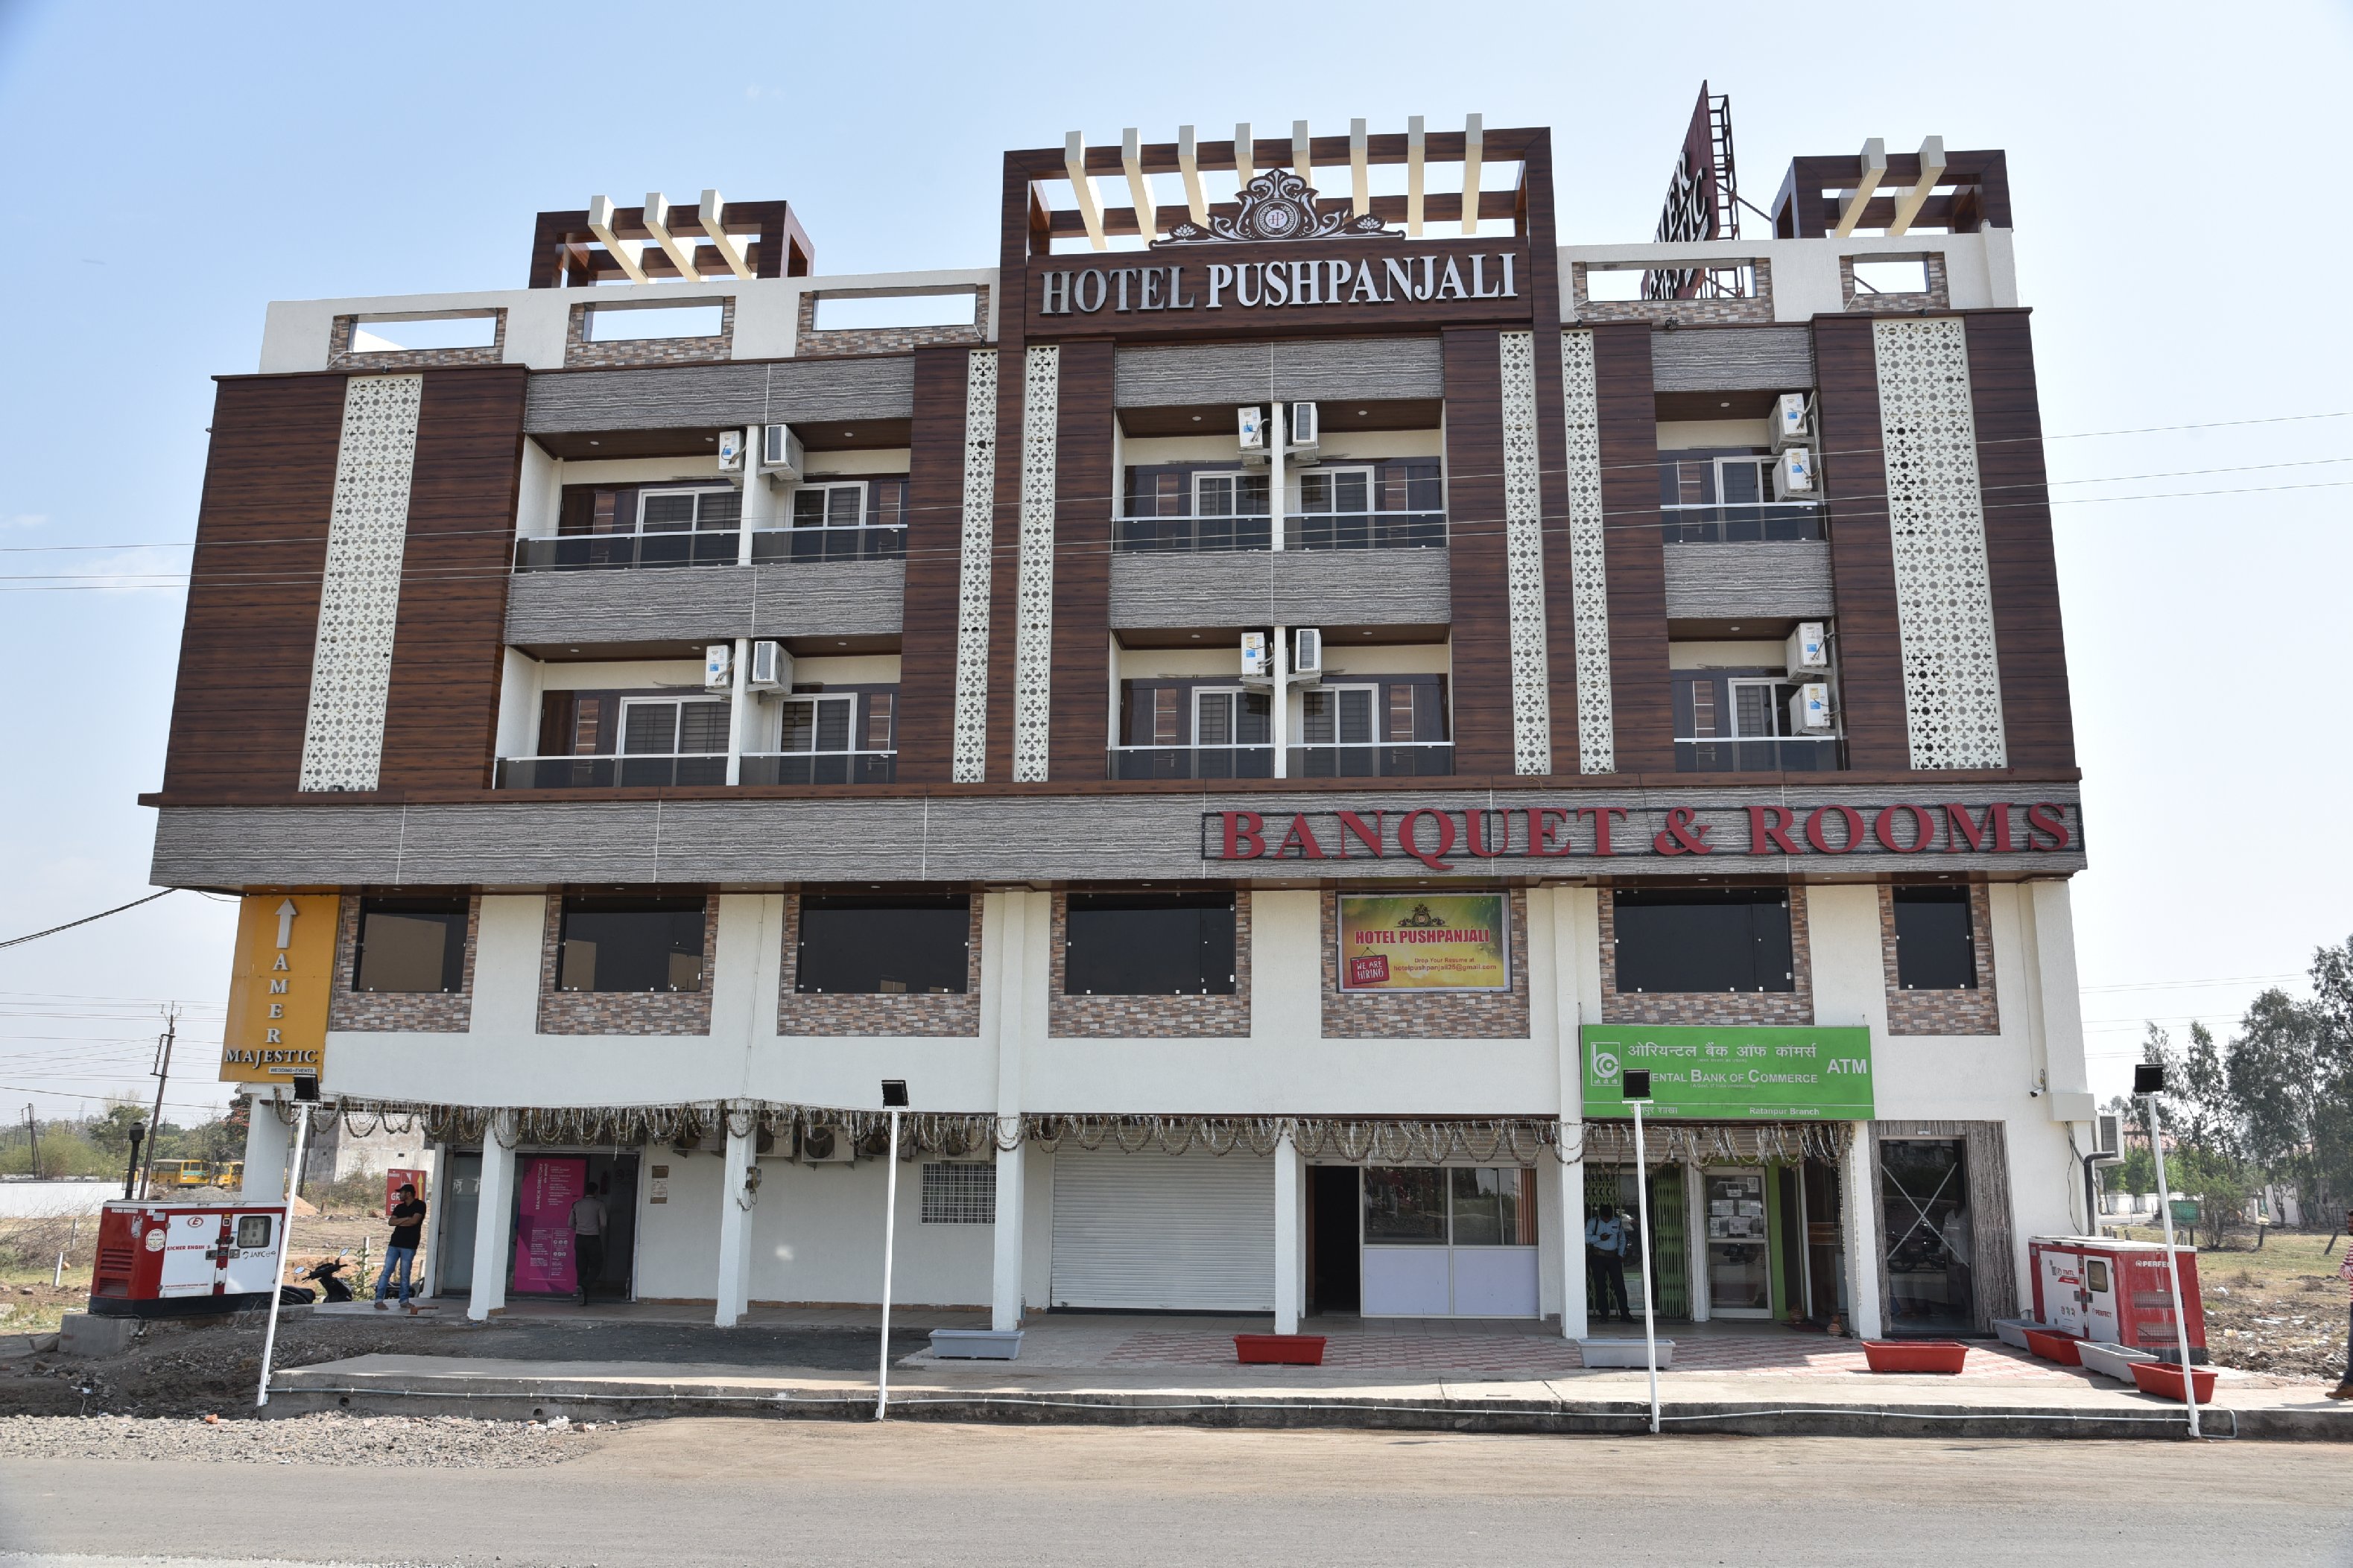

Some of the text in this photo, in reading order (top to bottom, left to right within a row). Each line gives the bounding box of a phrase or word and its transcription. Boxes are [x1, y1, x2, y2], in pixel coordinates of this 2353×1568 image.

[1040, 253, 1518, 314] HOTEL PUSHPANJALI
[1217, 801, 2071, 870] BANQUET & ROOMS
[1355, 929, 1490, 945] HOTEL PUSHPANJALI
[1356, 960, 1383, 970] WE ARE
[1357, 968, 1384, 980] HIRING
[1627, 1041, 1817, 1058] ओरियन्टल बैंक ऑफ कॉमर्स
[224, 1048, 318, 1069] MAJESTIC
[1826, 1058, 1867, 1074] ATM
[1691, 1069, 1727, 1082] BANK
[1748, 1069, 1818, 1084] COMMERCE
[1749, 1107, 1820, 1116] Ratanpur Branch
[2094, 1309, 2112, 1318] PERFECT
